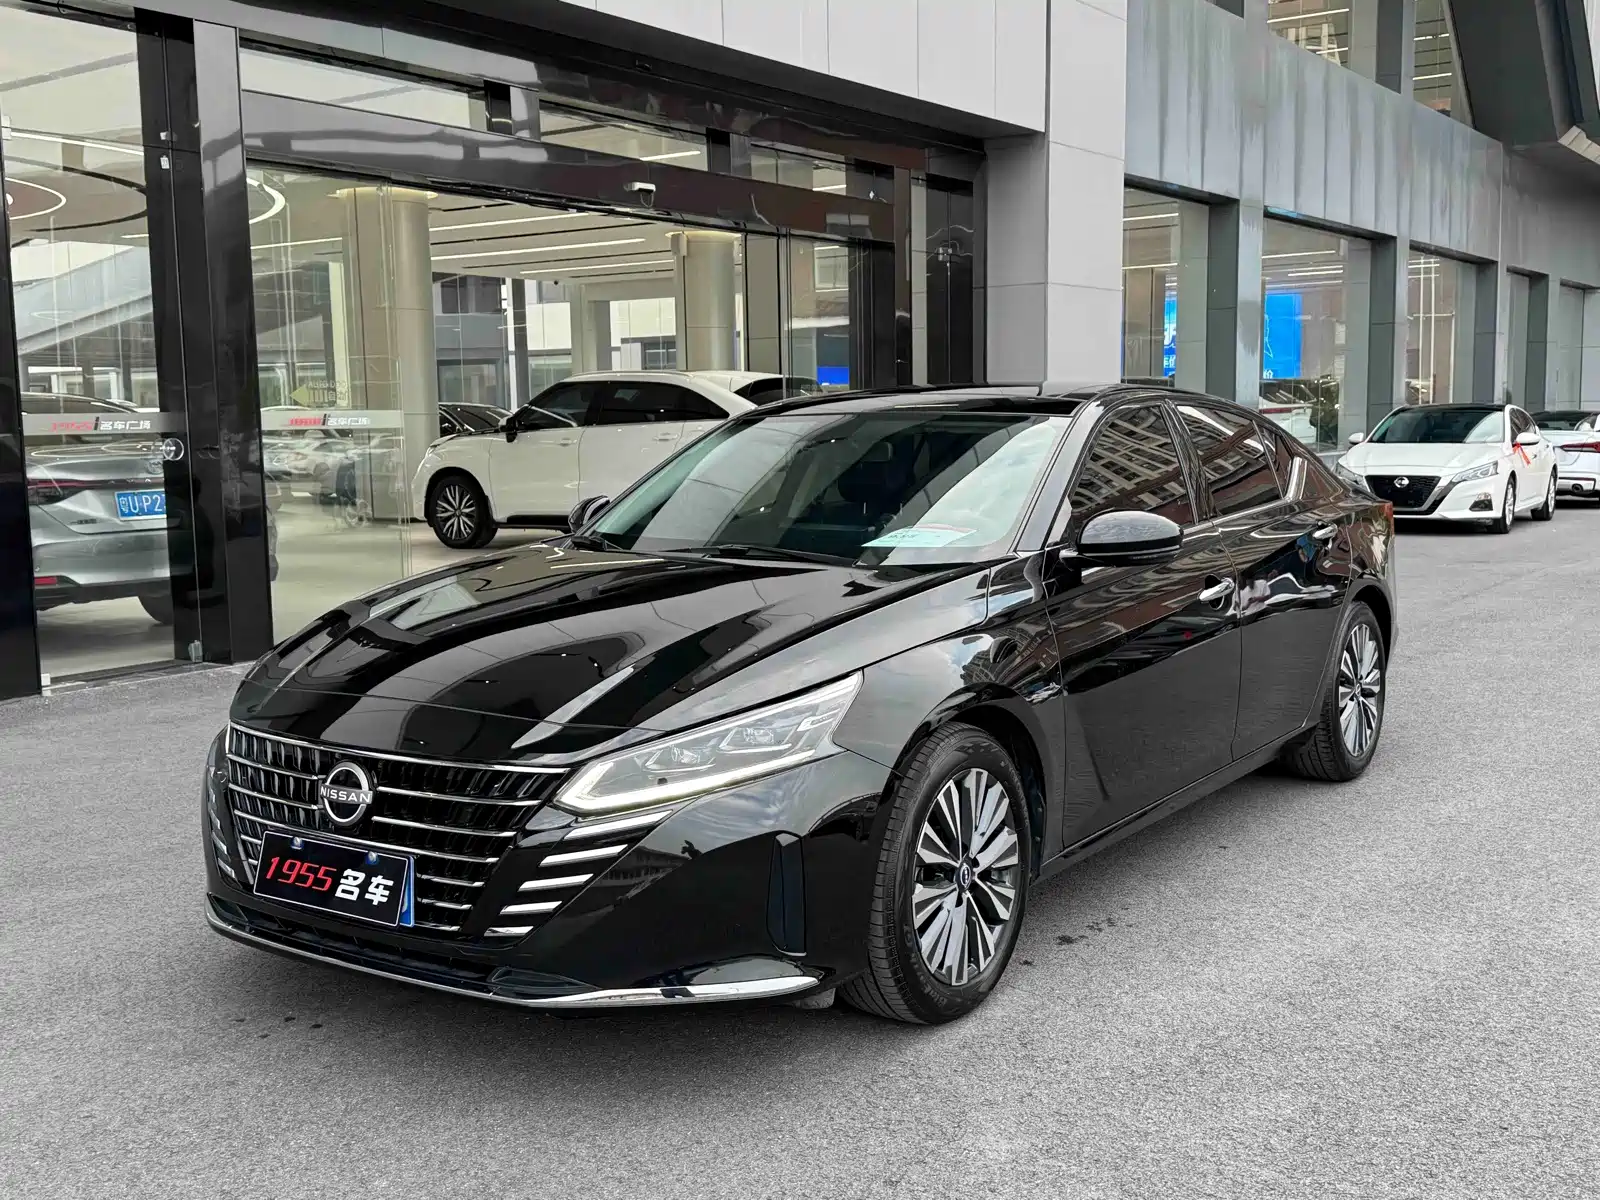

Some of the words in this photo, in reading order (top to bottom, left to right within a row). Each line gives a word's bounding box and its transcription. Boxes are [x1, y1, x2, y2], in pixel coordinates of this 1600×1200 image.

[100, 420, 151, 430] 名车广场
[119, 494, 166, 513] 粤UP2
[320, 786, 371, 803] NISSAN
[265, 856, 337, 891] 1955
[335, 868, 394, 906] 名车
